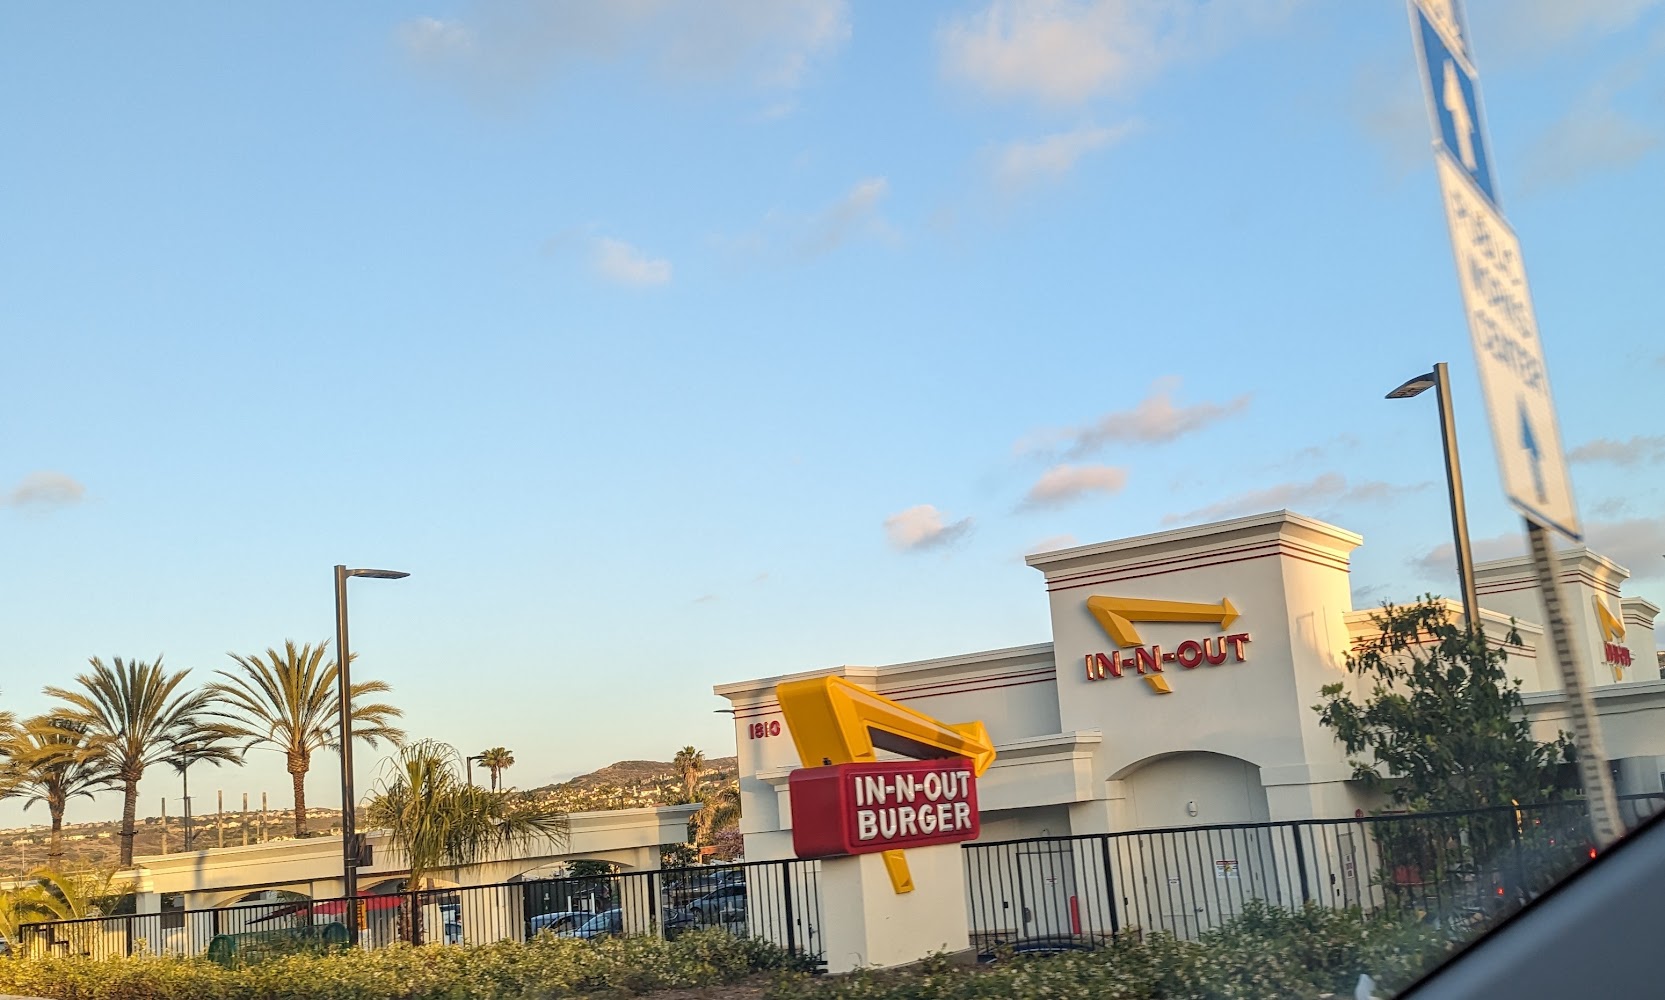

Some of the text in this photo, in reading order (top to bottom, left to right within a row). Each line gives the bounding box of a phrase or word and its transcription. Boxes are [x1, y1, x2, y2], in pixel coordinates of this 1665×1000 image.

[1085, 633, 1252, 681] IN-N-OUT
[749, 720, 781, 740] 1810
[855, 770, 971, 807] IN-N-OUT
[857, 801, 972, 841] BURGER
